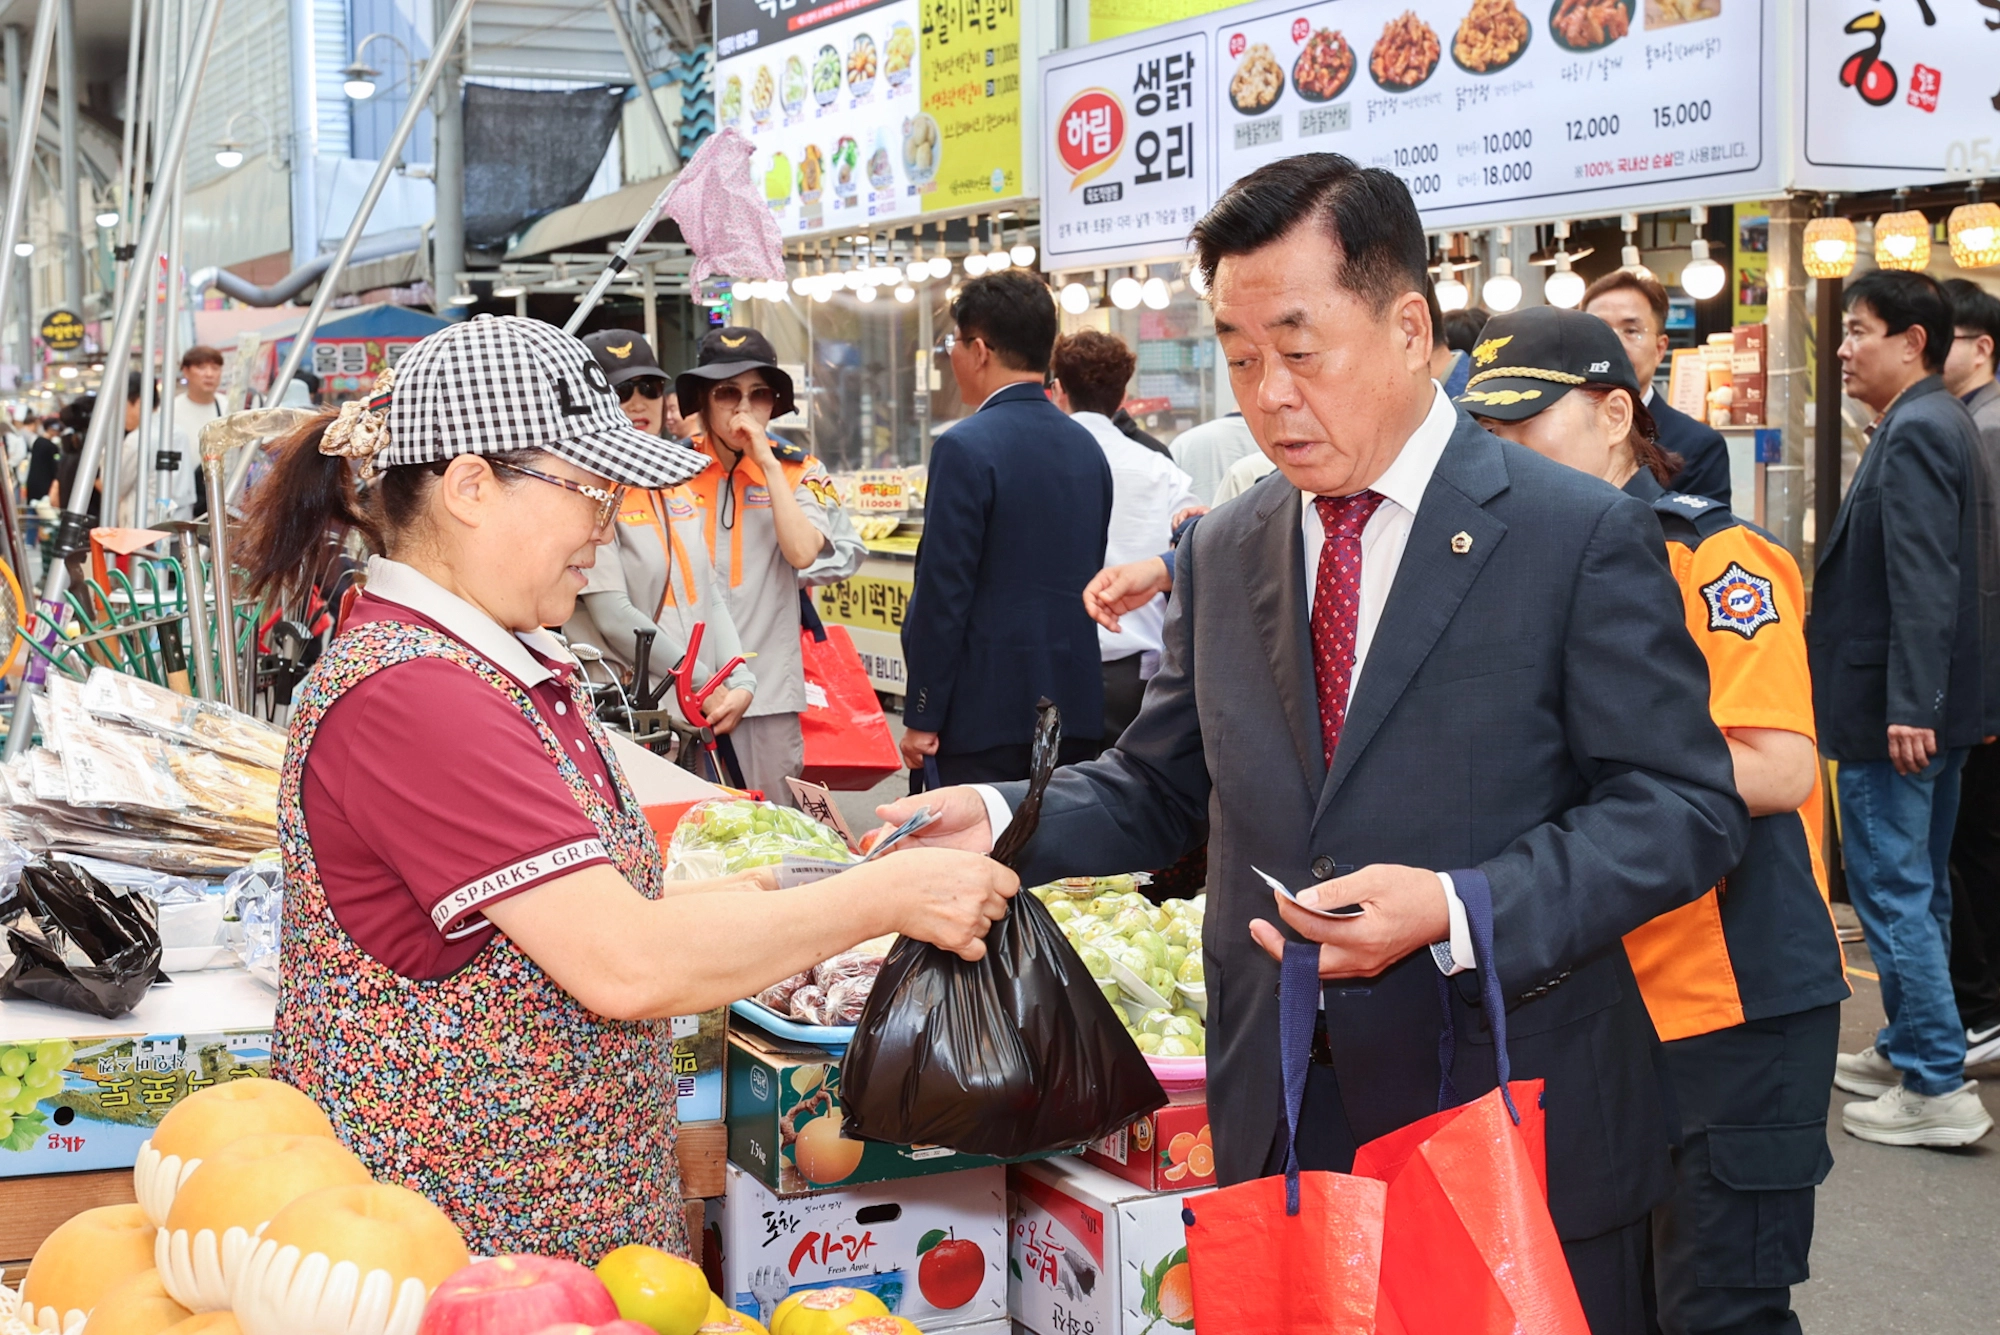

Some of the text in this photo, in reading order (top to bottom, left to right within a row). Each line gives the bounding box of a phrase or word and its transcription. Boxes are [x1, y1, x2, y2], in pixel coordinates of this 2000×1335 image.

[1134, 51, 1194, 116] 생닭
[1066, 104, 1111, 156] 하림
[1566, 114, 1620, 141] 12,000
[1653, 99, 1711, 128] 15,000
[1134, 122, 1194, 186] 오리
[1394, 143, 1438, 167] 10,000
[1483, 128, 1532, 154] 10,000
[1618, 155, 1649, 173] 국내산
[1688, 141, 1748, 164] 사용합니다.
[1945, 138, 2000, 179] 05
[1483, 161, 1532, 186] 18,000
[821, 580, 908, 627] 용철이떡갈
[454, 861, 540, 908] SPARKS
[48, 1133, 86, 1152] 4kg
[762, 1210, 801, 1248] 포항
[788, 1231, 878, 1278] 사과
[828, 1263, 870, 1275] Fresh Apple
